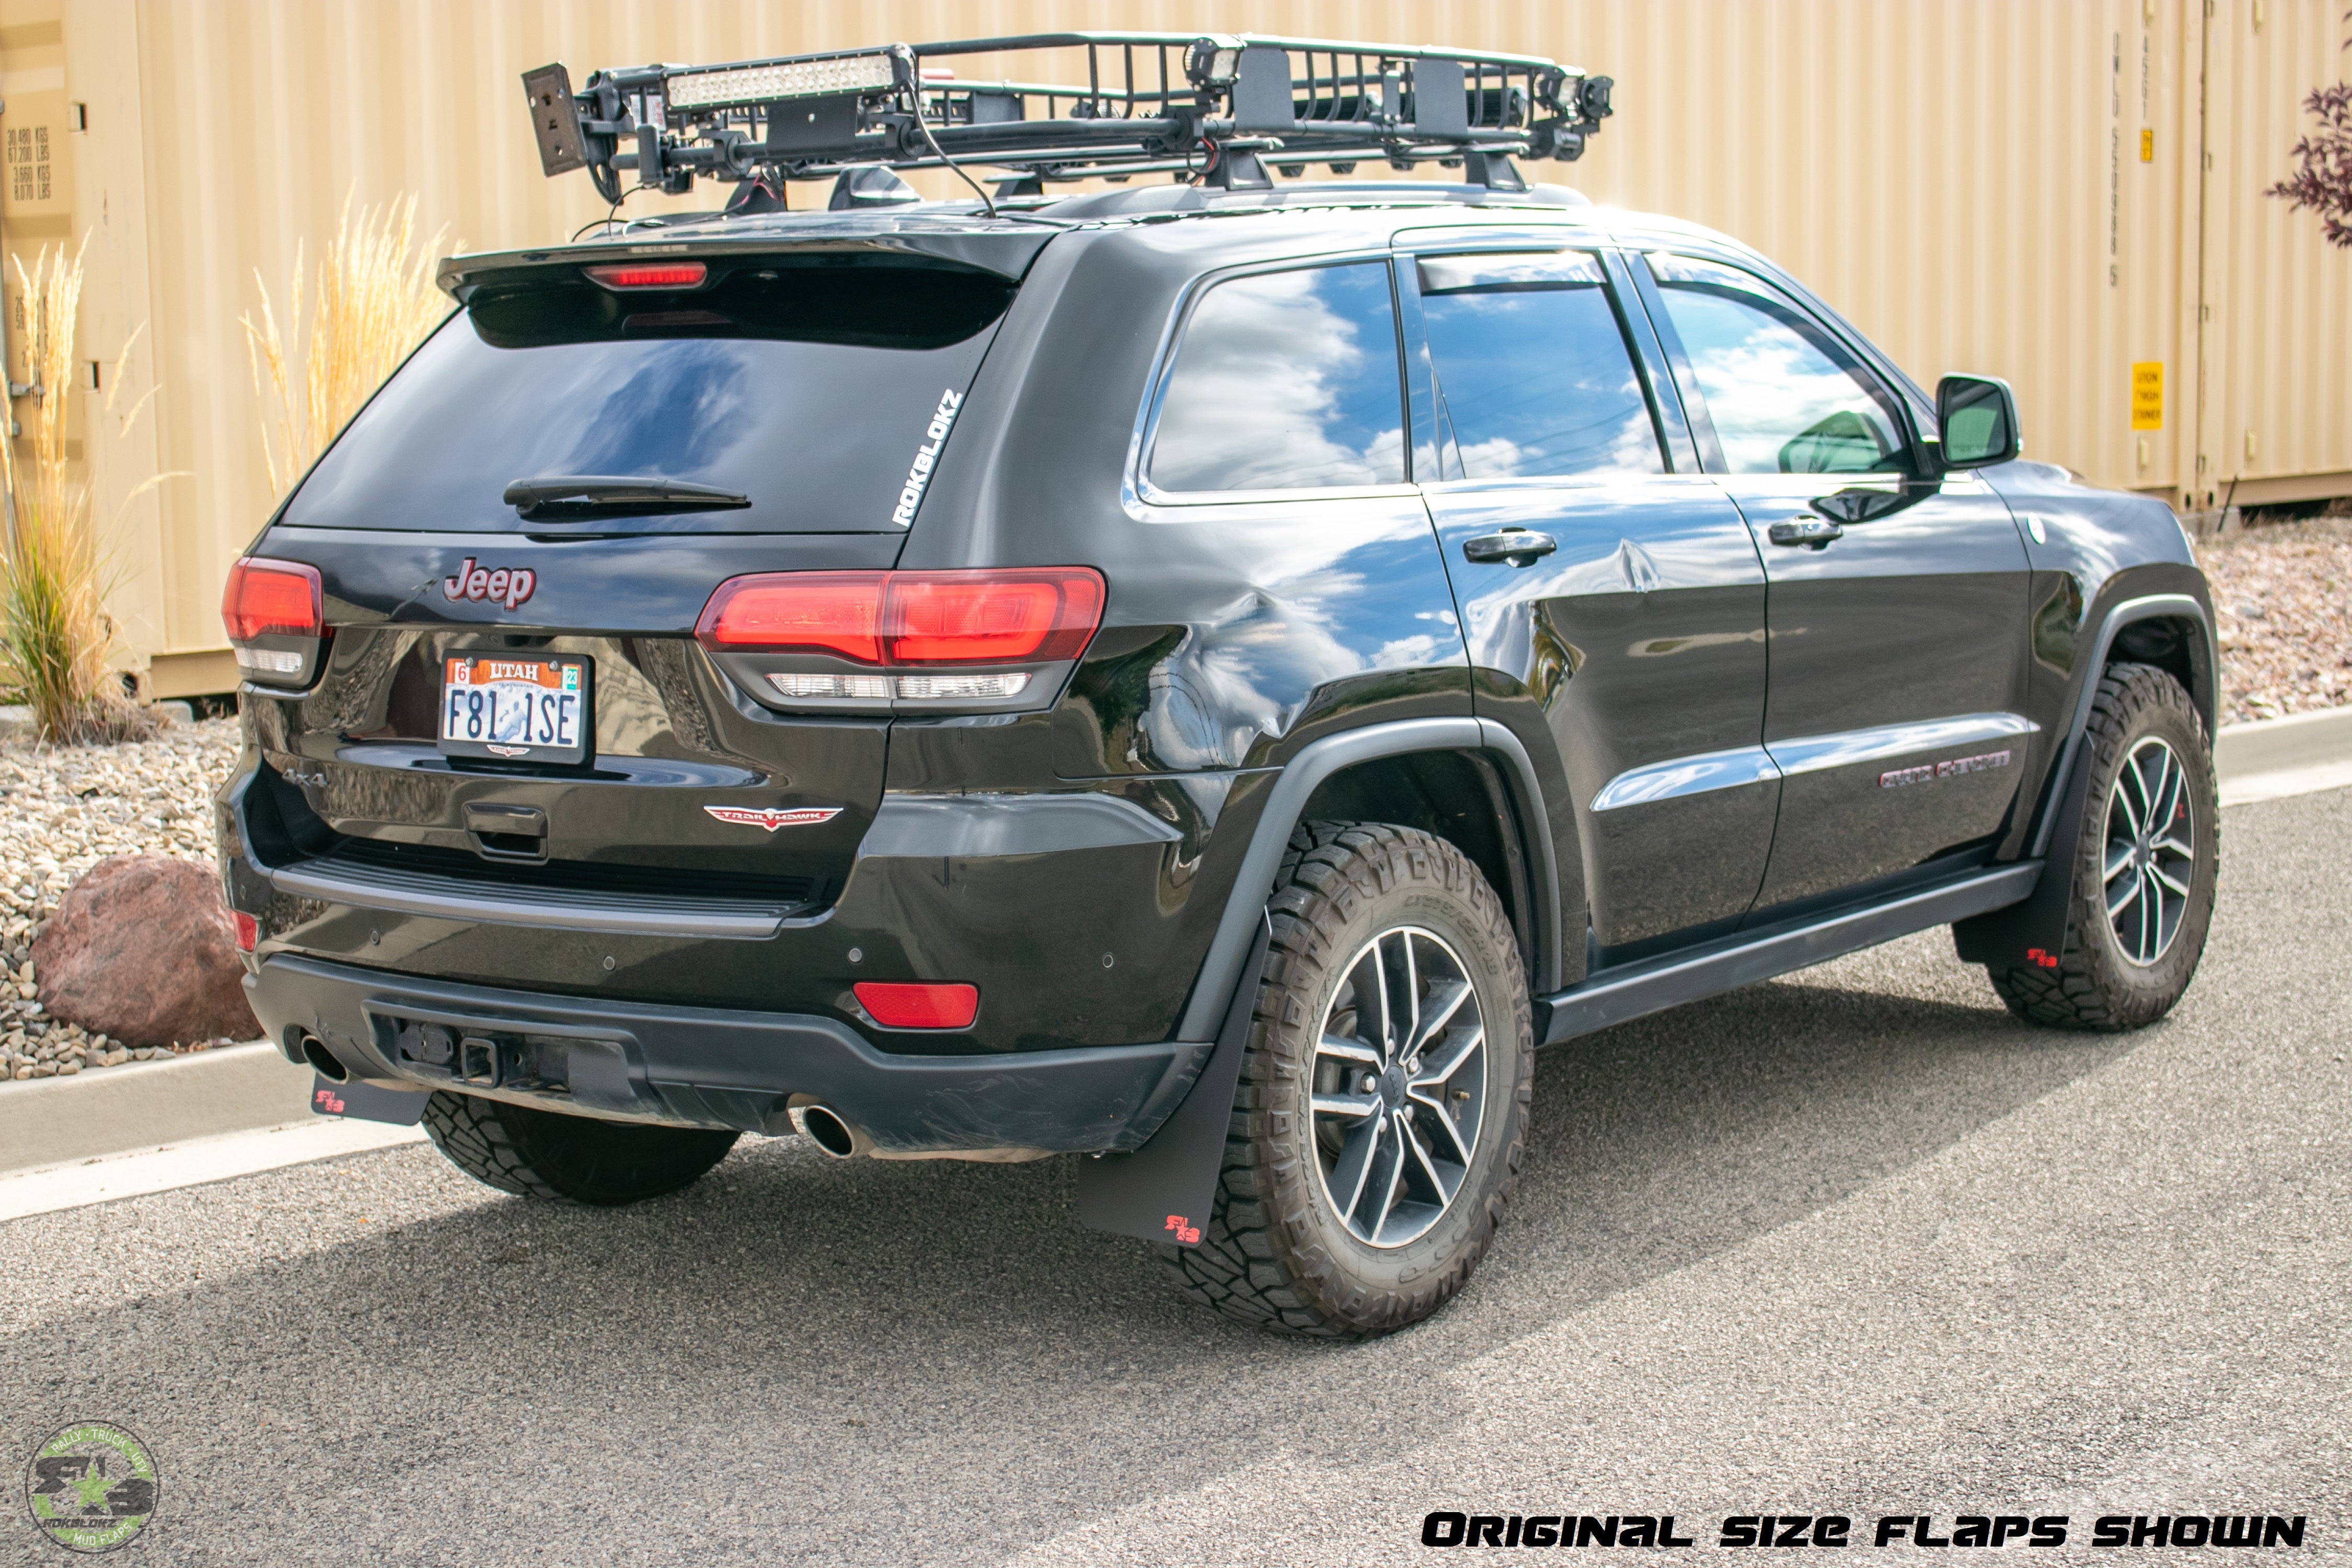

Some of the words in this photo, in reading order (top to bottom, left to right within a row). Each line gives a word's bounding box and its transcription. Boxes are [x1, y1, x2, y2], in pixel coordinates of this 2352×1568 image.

[35, 127, 49, 144] KGS
[36, 145, 50, 162] LBS
[37, 165, 51, 182] KGS
[38, 183, 51, 200] LBS
[892, 388, 963, 527] ROKBLOKZ
[443, 556, 537, 613] Jeep
[458, 665, 466, 681] 6
[489, 662, 538, 681] UTAH
[567, 670, 577, 685] 23
[449, 689, 497, 740] F81
[523, 693, 575, 745] 1SE
[1878, 765, 1932, 788] GRAND
